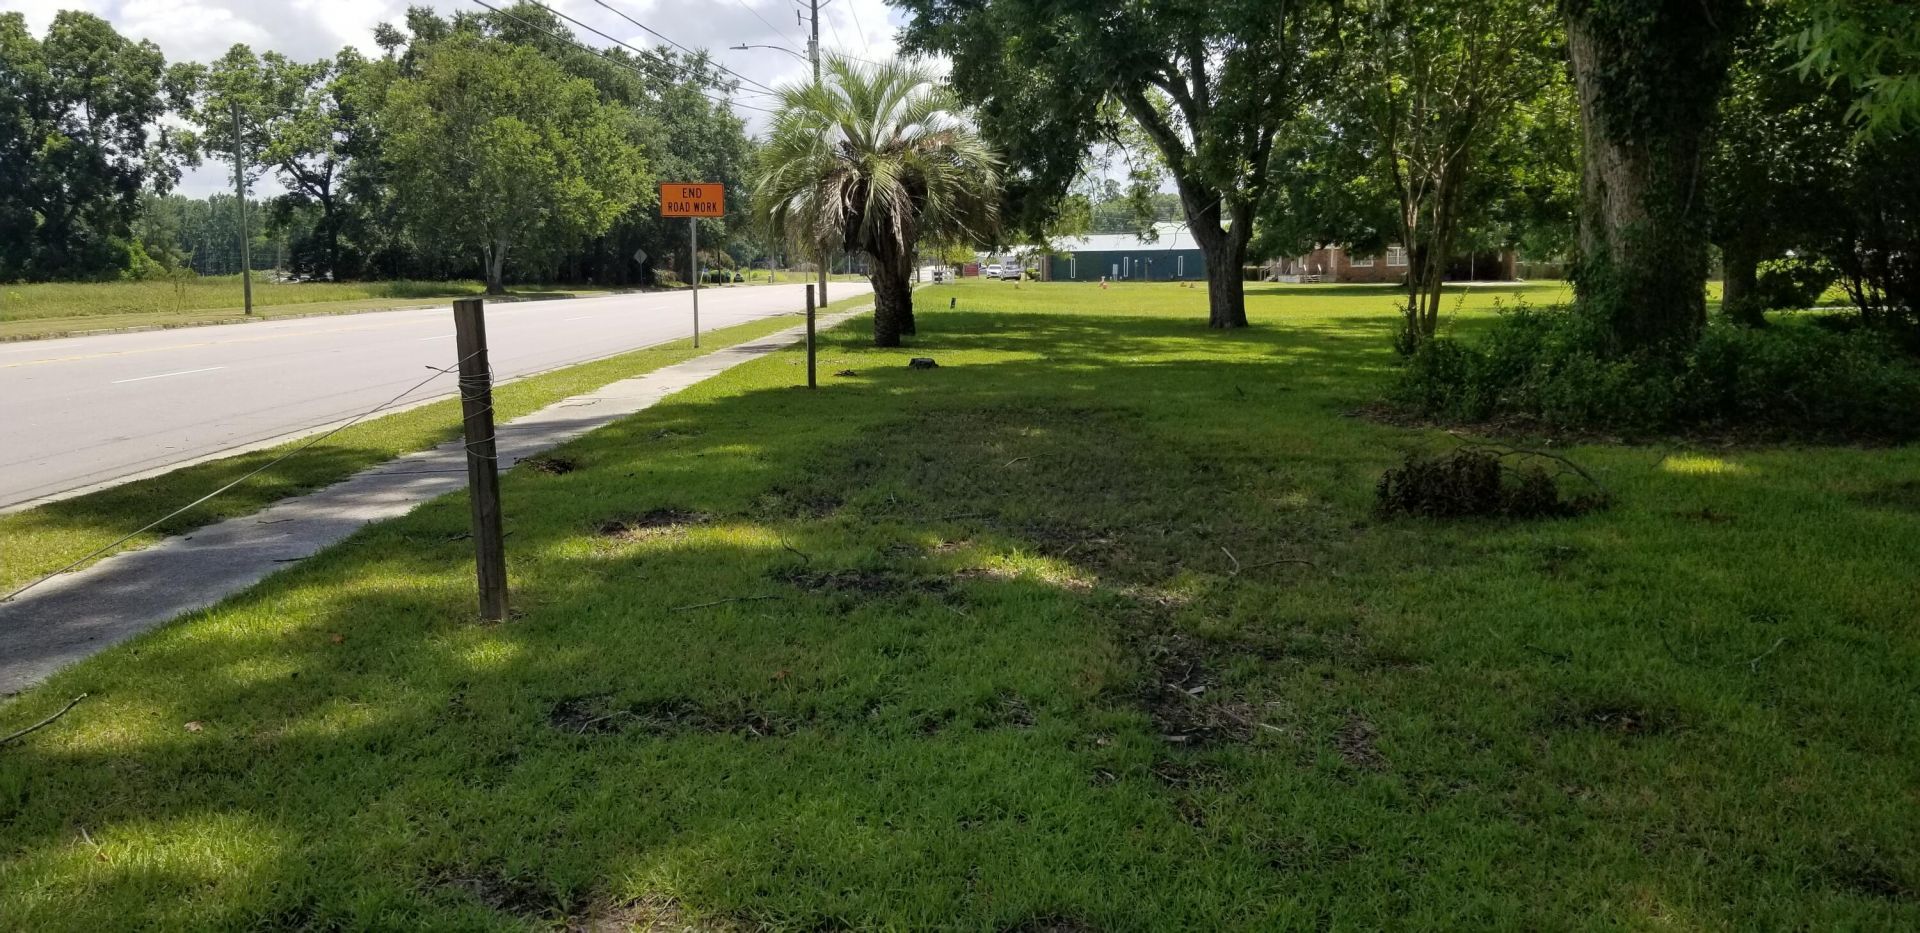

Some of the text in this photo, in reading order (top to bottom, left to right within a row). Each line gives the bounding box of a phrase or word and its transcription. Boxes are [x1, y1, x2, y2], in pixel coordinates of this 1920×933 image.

[682, 188, 702, 199] END
[668, 202, 717, 212] ROAD WORK
